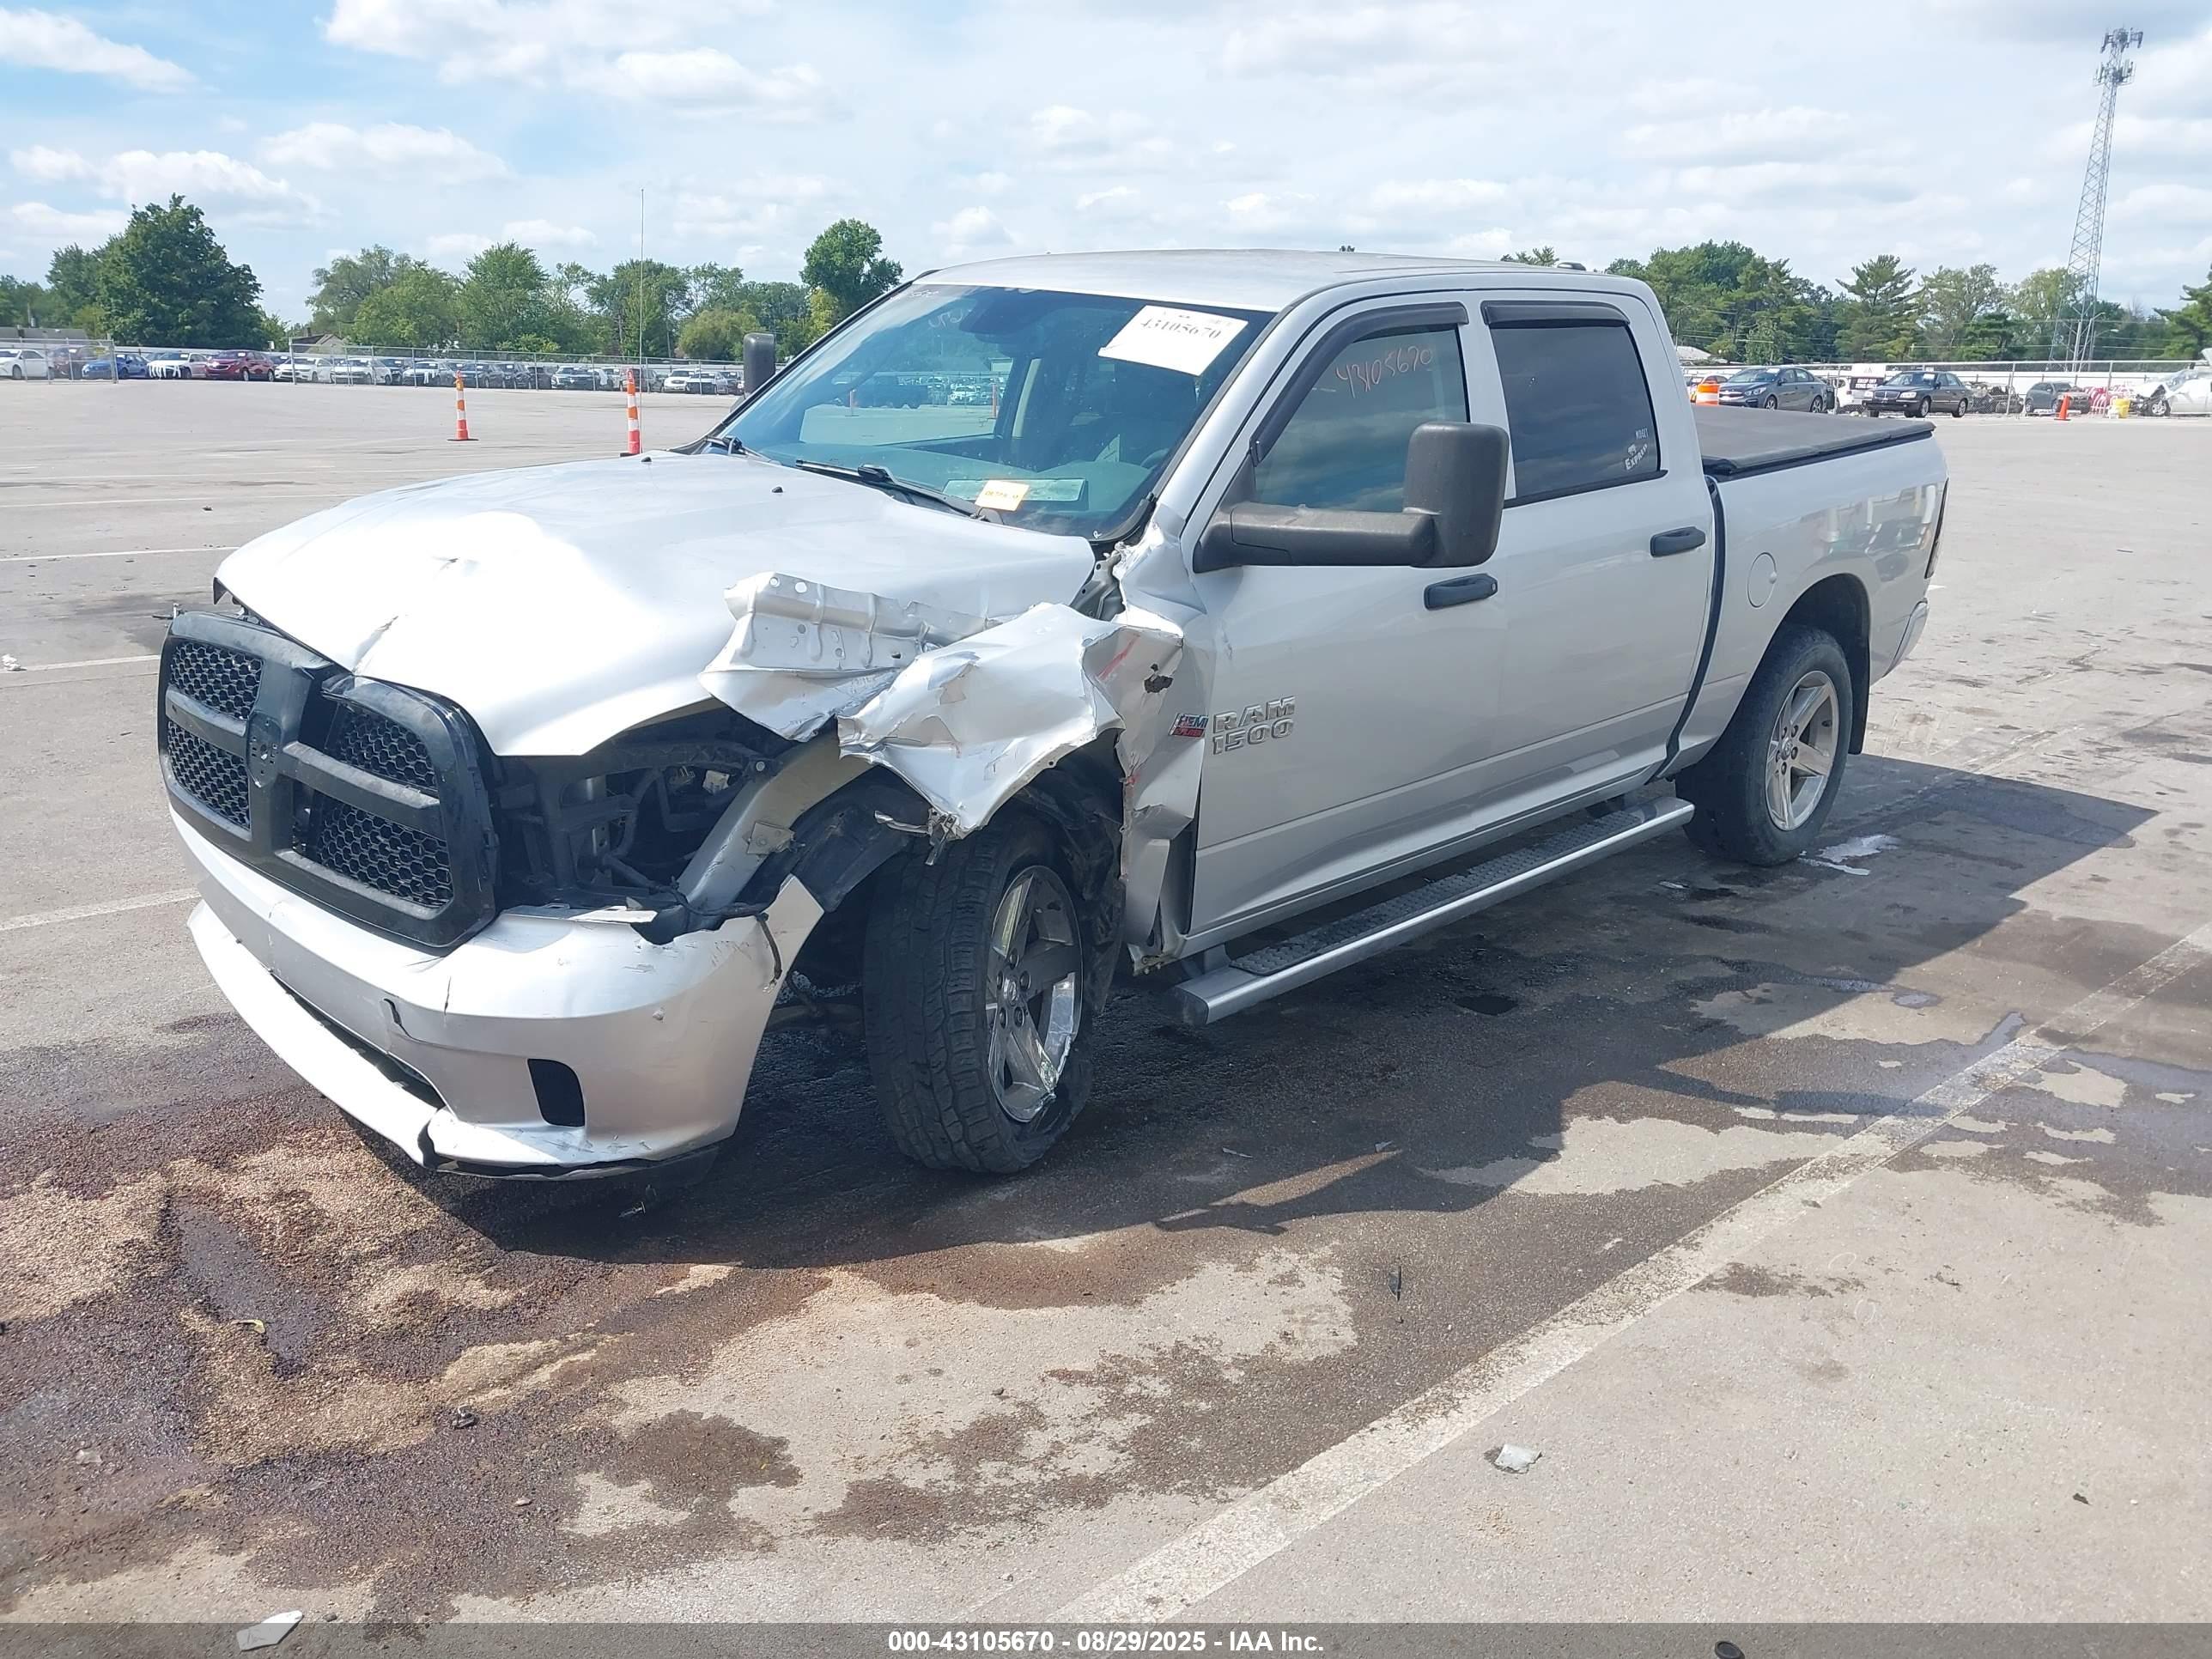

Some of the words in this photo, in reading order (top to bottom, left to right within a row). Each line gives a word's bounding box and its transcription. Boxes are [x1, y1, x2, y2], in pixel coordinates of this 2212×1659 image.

[1335, 346, 1434, 398] 43105670
[1177, 714, 1209, 728] HEMI
[1212, 696, 1296, 733] RAM
[1212, 718, 1294, 756] 1500
